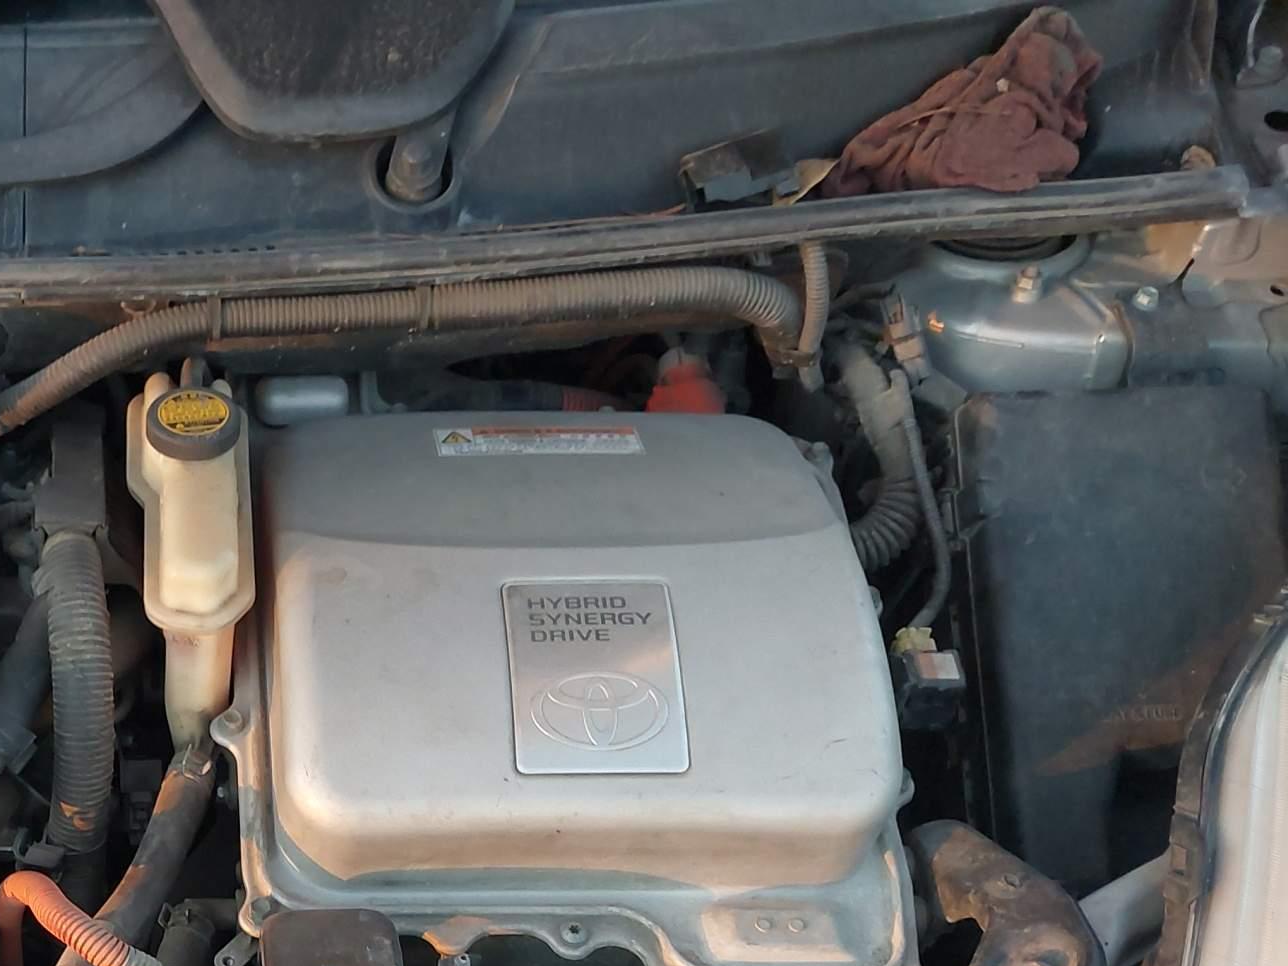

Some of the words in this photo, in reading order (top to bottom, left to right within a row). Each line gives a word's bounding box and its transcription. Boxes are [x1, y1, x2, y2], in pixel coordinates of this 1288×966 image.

[527, 596, 627, 610] HYBRID
[529, 612, 652, 627] SYNERGY
[530, 629, 611, 643] DRIVE
